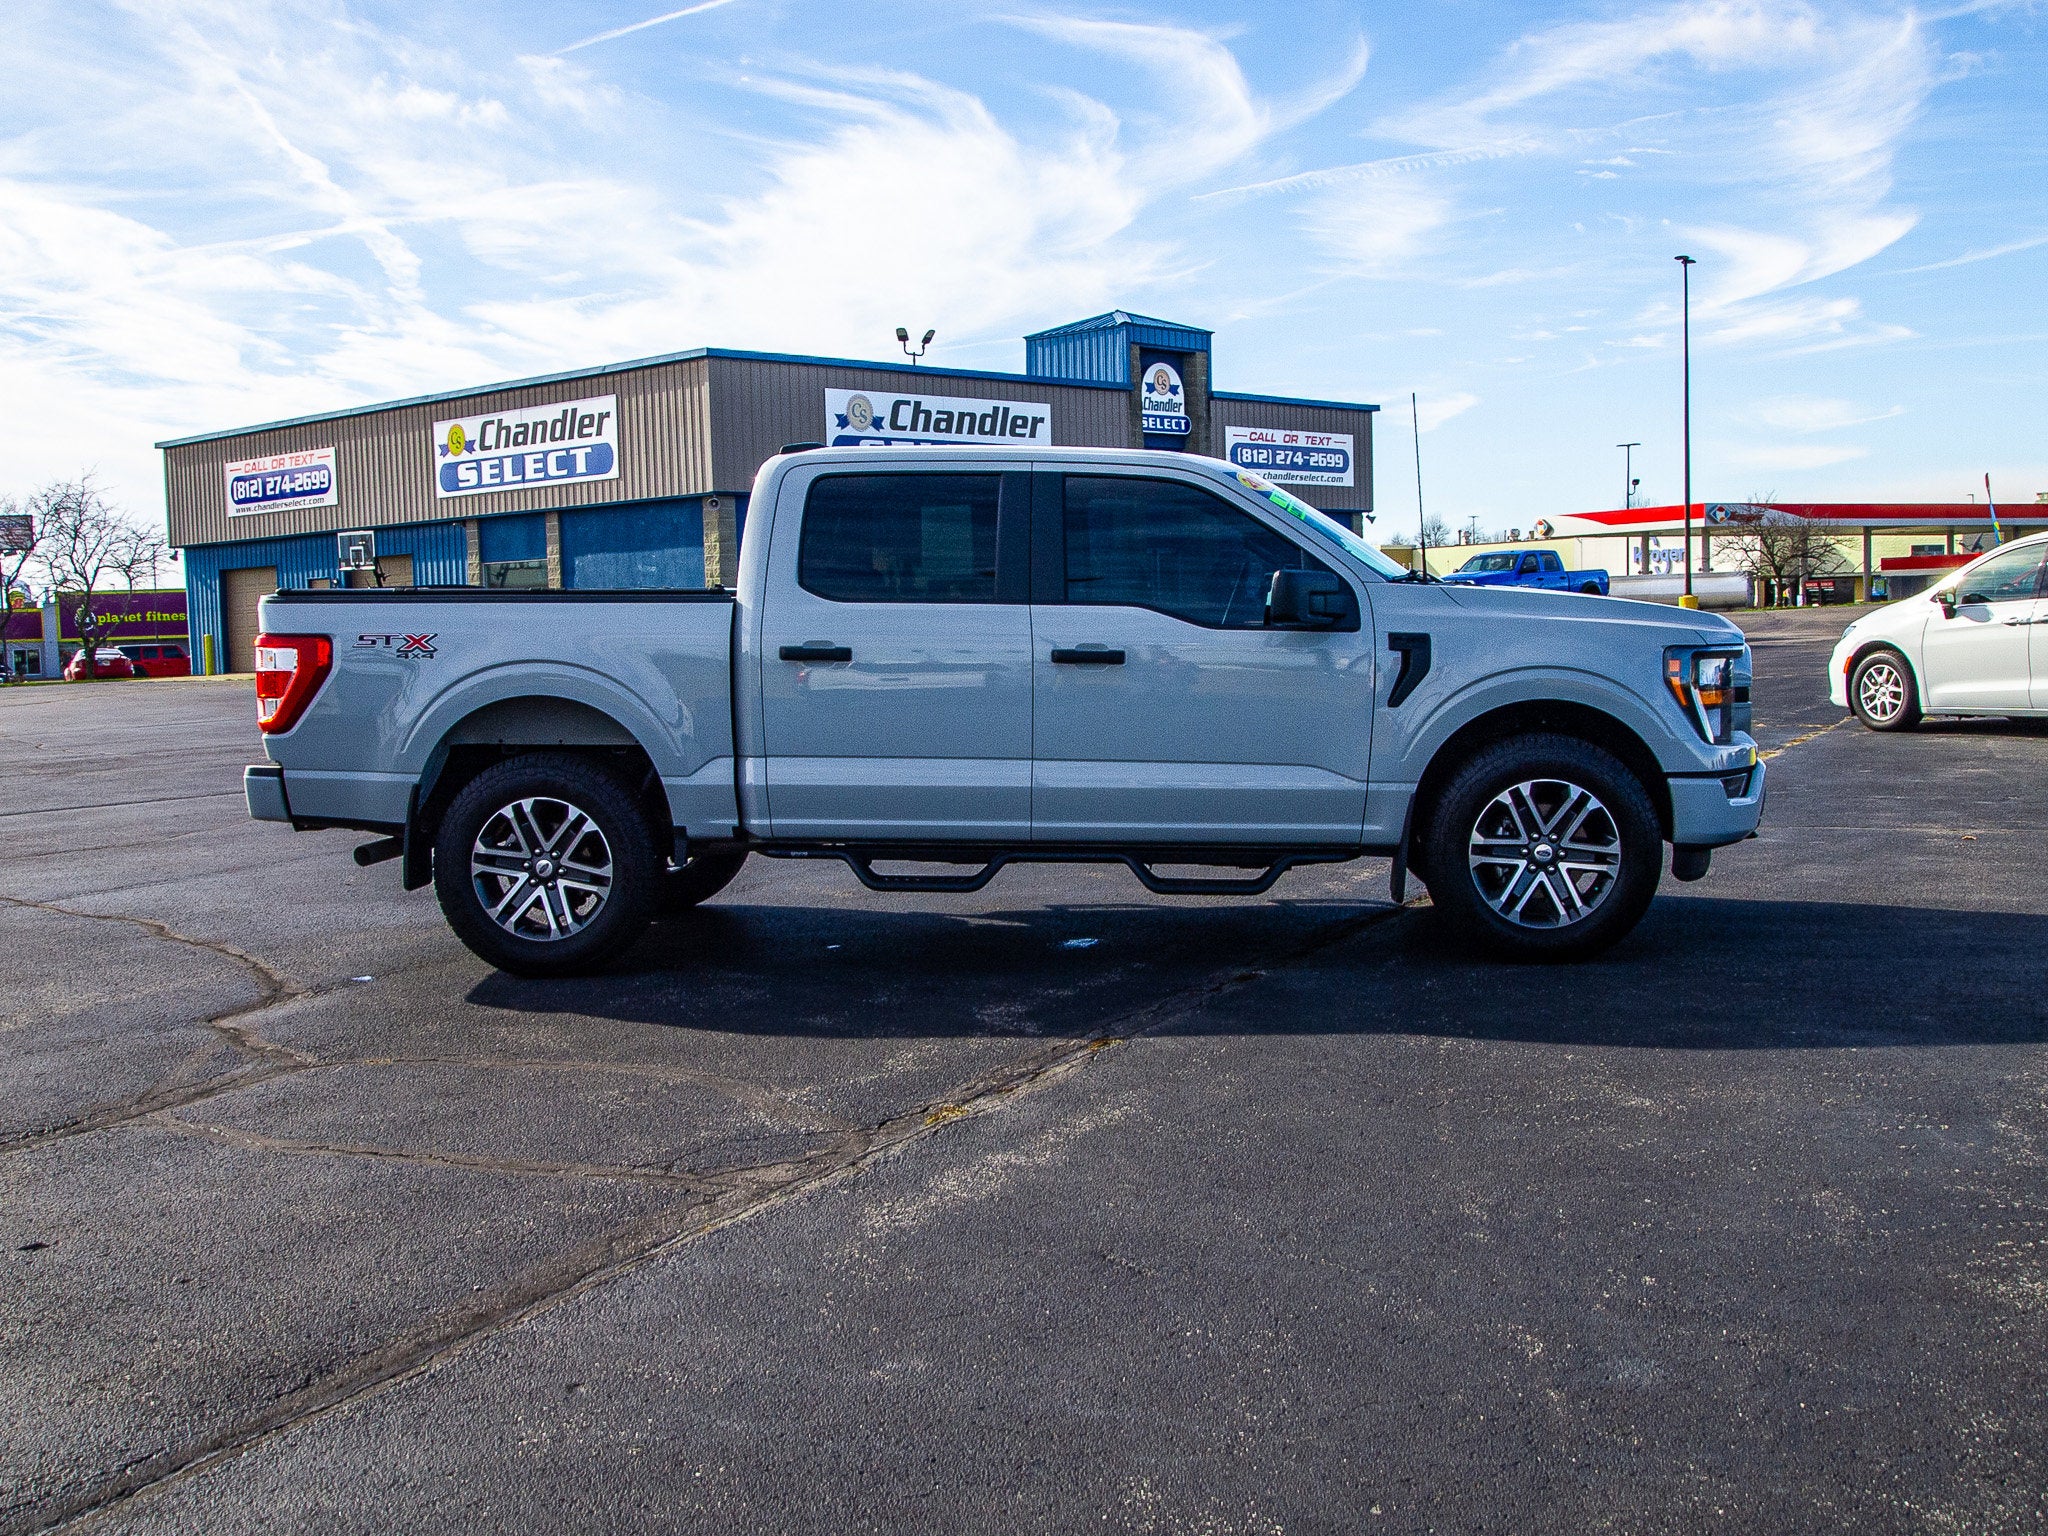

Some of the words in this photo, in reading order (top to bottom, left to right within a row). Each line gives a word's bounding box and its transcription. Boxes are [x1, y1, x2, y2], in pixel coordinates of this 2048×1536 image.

[851, 403, 868, 424] CS
[1143, 397, 1183, 413] Chandler
[889, 399, 1045, 438] Chandler
[1142, 417, 1187, 430] SELECT
[479, 408, 611, 451] Chandler
[1249, 431, 1277, 443] CALL
[1283, 433, 1299, 444] OR
[1304, 435, 1332, 446] TEXT
[244, 461, 268, 474] CALL
[271, 458, 286, 469] OR
[289, 453, 315, 466] TEXT
[1237, 447, 1272, 465] (812)
[1275, 450, 1344, 467] 274-2699
[457, 447, 592, 488] SELECT
[1255, 471, 1344, 483] chandlerselect.com
[233, 478, 263, 500] (812)
[266, 470, 329, 496] 274-2699
[235, 497, 325, 514] www.chandlerselect.com
[1634, 537, 1685, 575] Koger
[352, 633, 438, 653] STX
